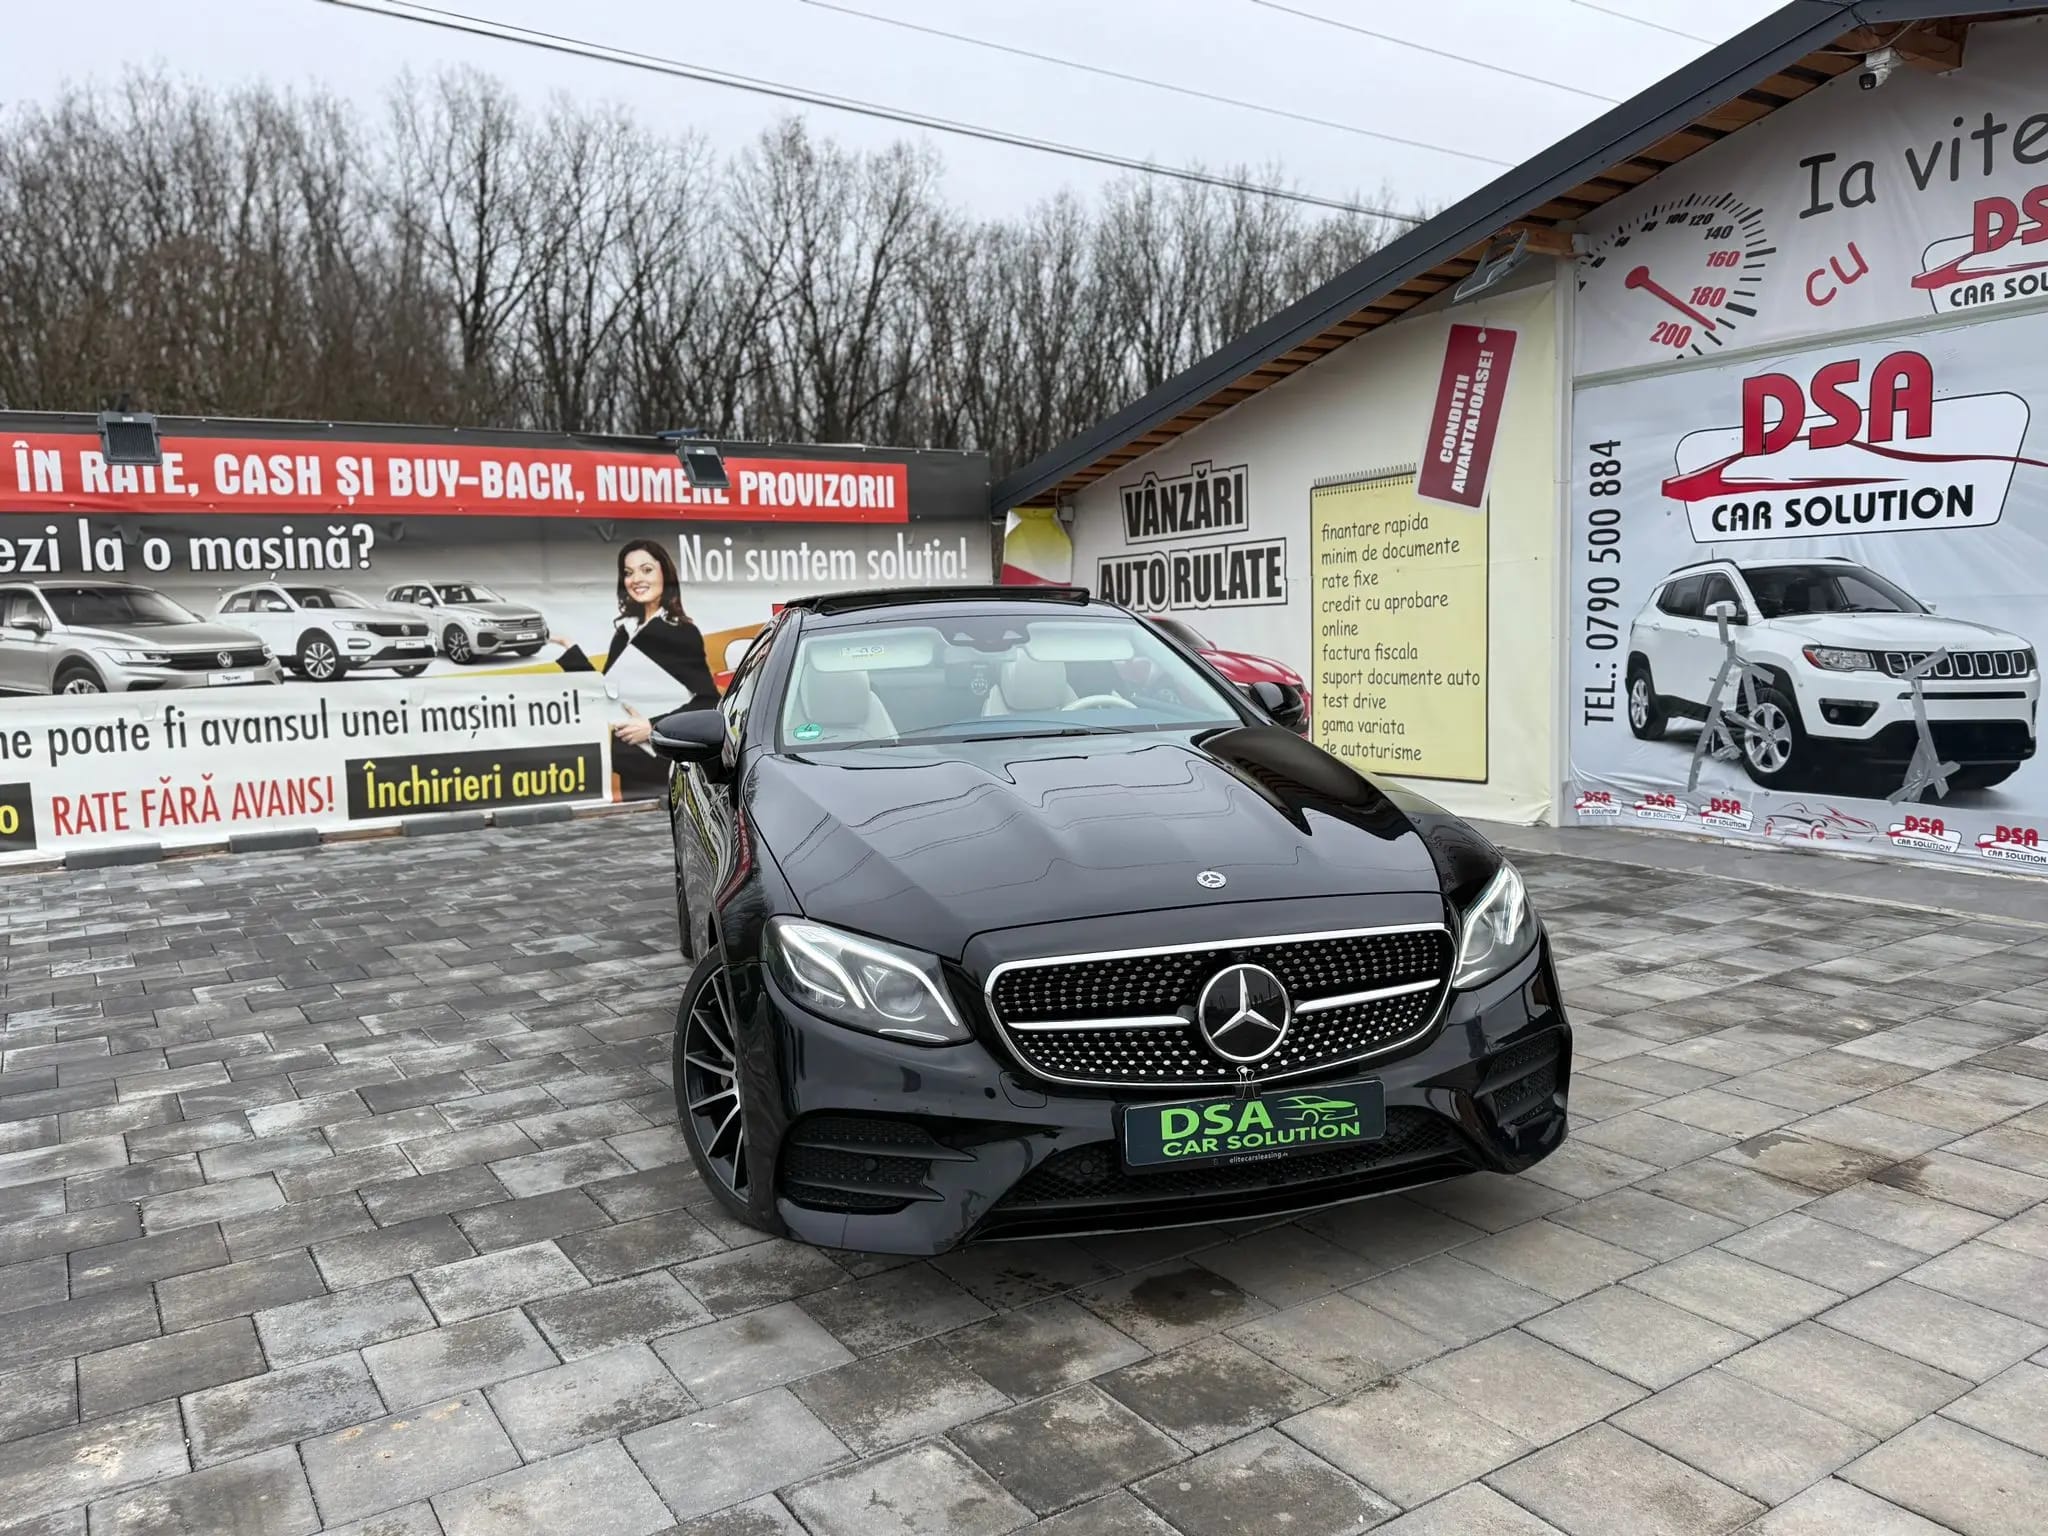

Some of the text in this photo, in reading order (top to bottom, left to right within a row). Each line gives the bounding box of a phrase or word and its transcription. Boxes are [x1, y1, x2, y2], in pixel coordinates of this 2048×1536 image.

[1799, 112, 2048, 219] Ia vite
[1688, 213, 1715, 226] 120
[1704, 225, 1734, 240] 140
[1706, 251, 1740, 267] 160
[1806, 241, 1869, 306] cu
[1689, 287, 1726, 307] 180
[1950, 282, 1995, 307] CAR
[1650, 321, 1692, 348] 200
[1743, 351, 1934, 456] DSA
[1440, 374, 1470, 463] CONDITII
[1451, 350, 1495, 494] AVANTAJOASE!
[12, 440, 63, 492] ÎN
[80, 450, 199, 497] RATE,
[214, 454, 321, 496] CASH
[336, 456, 374, 505] ȘI
[388, 458, 585, 503] BUY-BACK,
[740, 471, 895, 508] PROVIZORII
[1124, 469, 1243, 538] VÂNZĂRI
[1712, 484, 1974, 532] CAR SOLUTION
[1321, 512, 1429, 542] finantare rapida
[78, 518, 124, 572] la
[143, 537, 172, 572] o
[189, 523, 374, 580] mașină?
[679, 532, 968, 586] Noi suntem soluția!
[1321, 537, 1460, 565] minim de documente
[1100, 547, 1282, 606] AUTO RULATE
[1322, 569, 1379, 589] rate fixe
[1584, 439, 1622, 726] TEL.: 0790 500 884
[1322, 590, 1448, 614] credit cu aprobare
[1322, 619, 1359, 637] online
[1322, 641, 1418, 661] factura fiscala
[1322, 668, 1480, 689] suport documente auto
[1322, 692, 1387, 709] test drive
[48, 718, 150, 767] poate
[164, 706, 187, 748] fi
[201, 698, 328, 746] avansul
[342, 699, 408, 737] unei
[421, 694, 516, 738] mașini
[528, 689, 581, 726] noi!
[1322, 718, 1405, 736] gama variata
[1323, 738, 1422, 761] de autoturisme
[363, 756, 585, 809] Închirieri auto!
[52, 772, 334, 836] RATE FĂRĂ AVANS!
[1584, 791, 1612, 803] DSA
[1644, 793, 1676, 807] DSA
[1710, 797, 1741, 815] DSA
[1652, 812, 1681, 820] SOLUTION
[1718, 819, 1747, 829] SOLUTION
[1905, 815, 1945, 836] DSA
[1913, 840, 1952, 852] SOLUTION
[1996, 825, 2038, 847] DSA
[2005, 851, 2047, 863] SOLUTION
[1161, 1100, 1274, 1140] DSA
[1162, 1121, 1360, 1156] CAR SOLUTION
